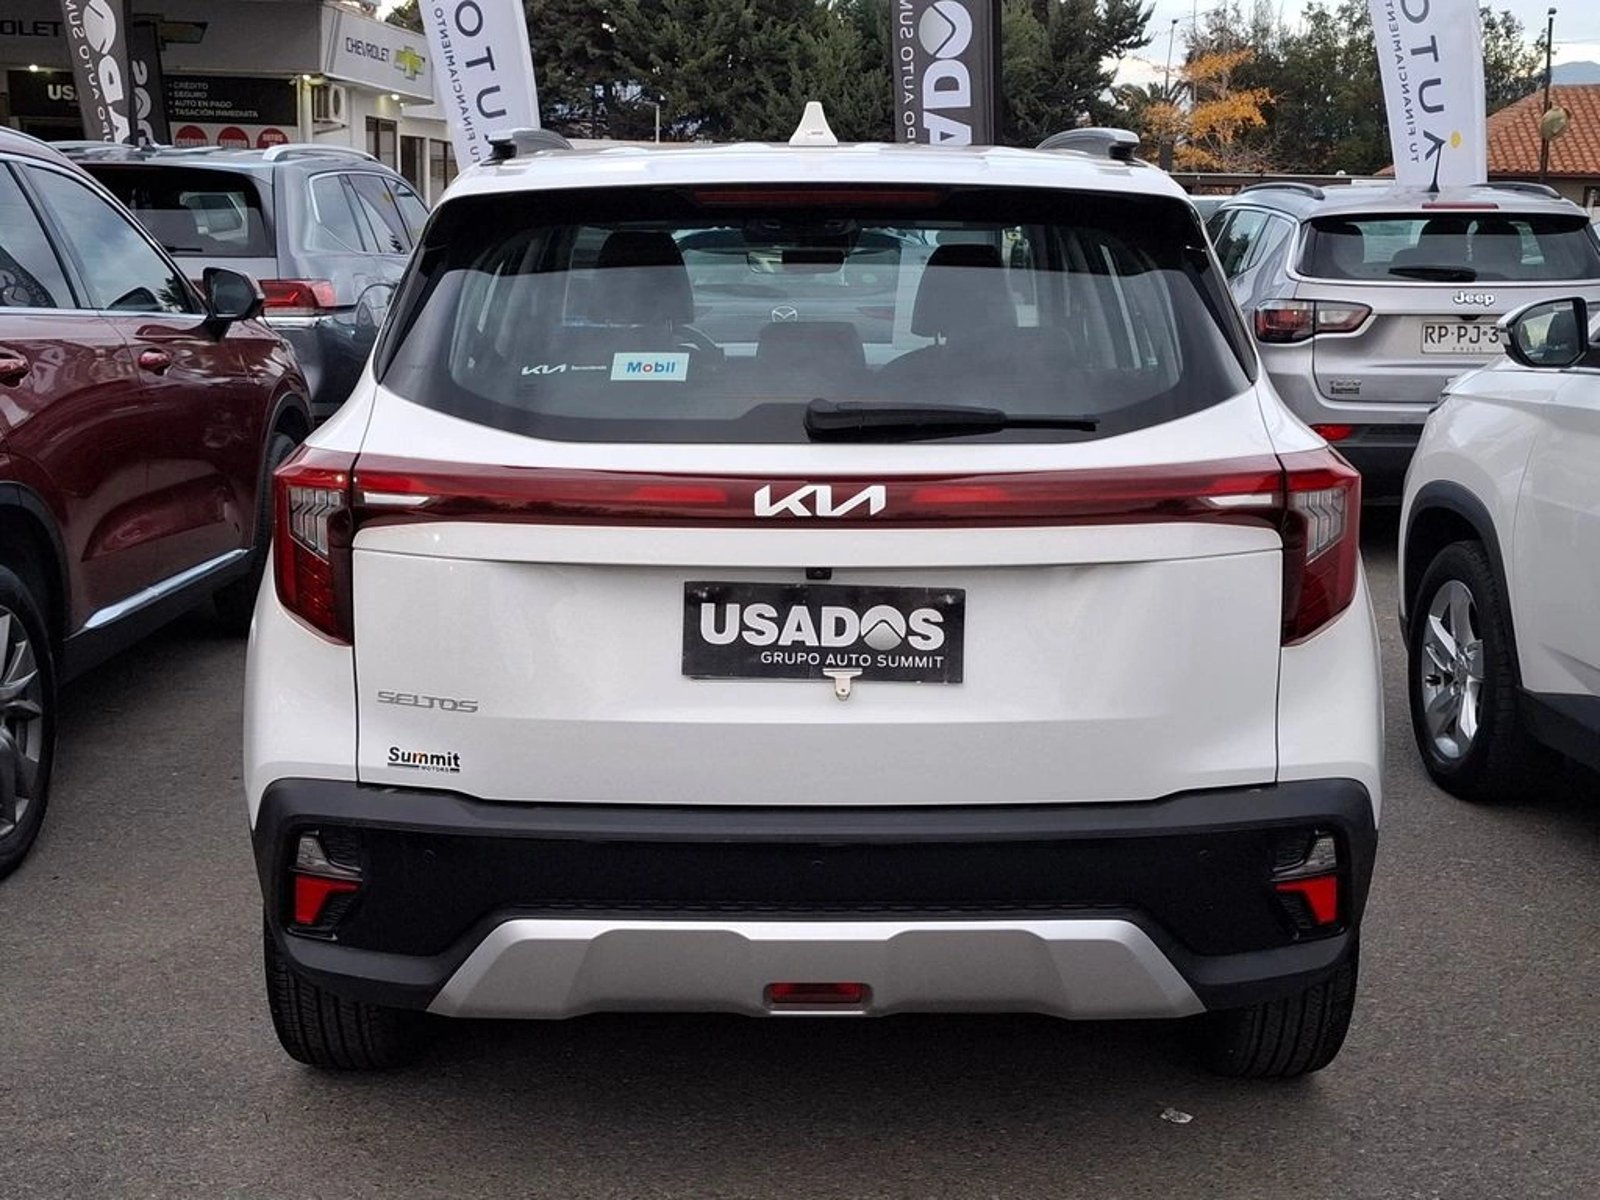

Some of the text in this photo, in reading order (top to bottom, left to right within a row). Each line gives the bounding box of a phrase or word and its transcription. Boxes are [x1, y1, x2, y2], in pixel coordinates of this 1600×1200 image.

[47, 84, 79, 101] US
[1453, 291, 1496, 307] Jeep
[626, 361, 676, 373] Mobil
[754, 484, 886, 517] KIA
[700, 602, 945, 651] USADOS
[760, 651, 945, 669] GRUPO AUTO SUMMIT
[378, 691, 479, 713] SELTOS
[388, 746, 461, 768] Summit
